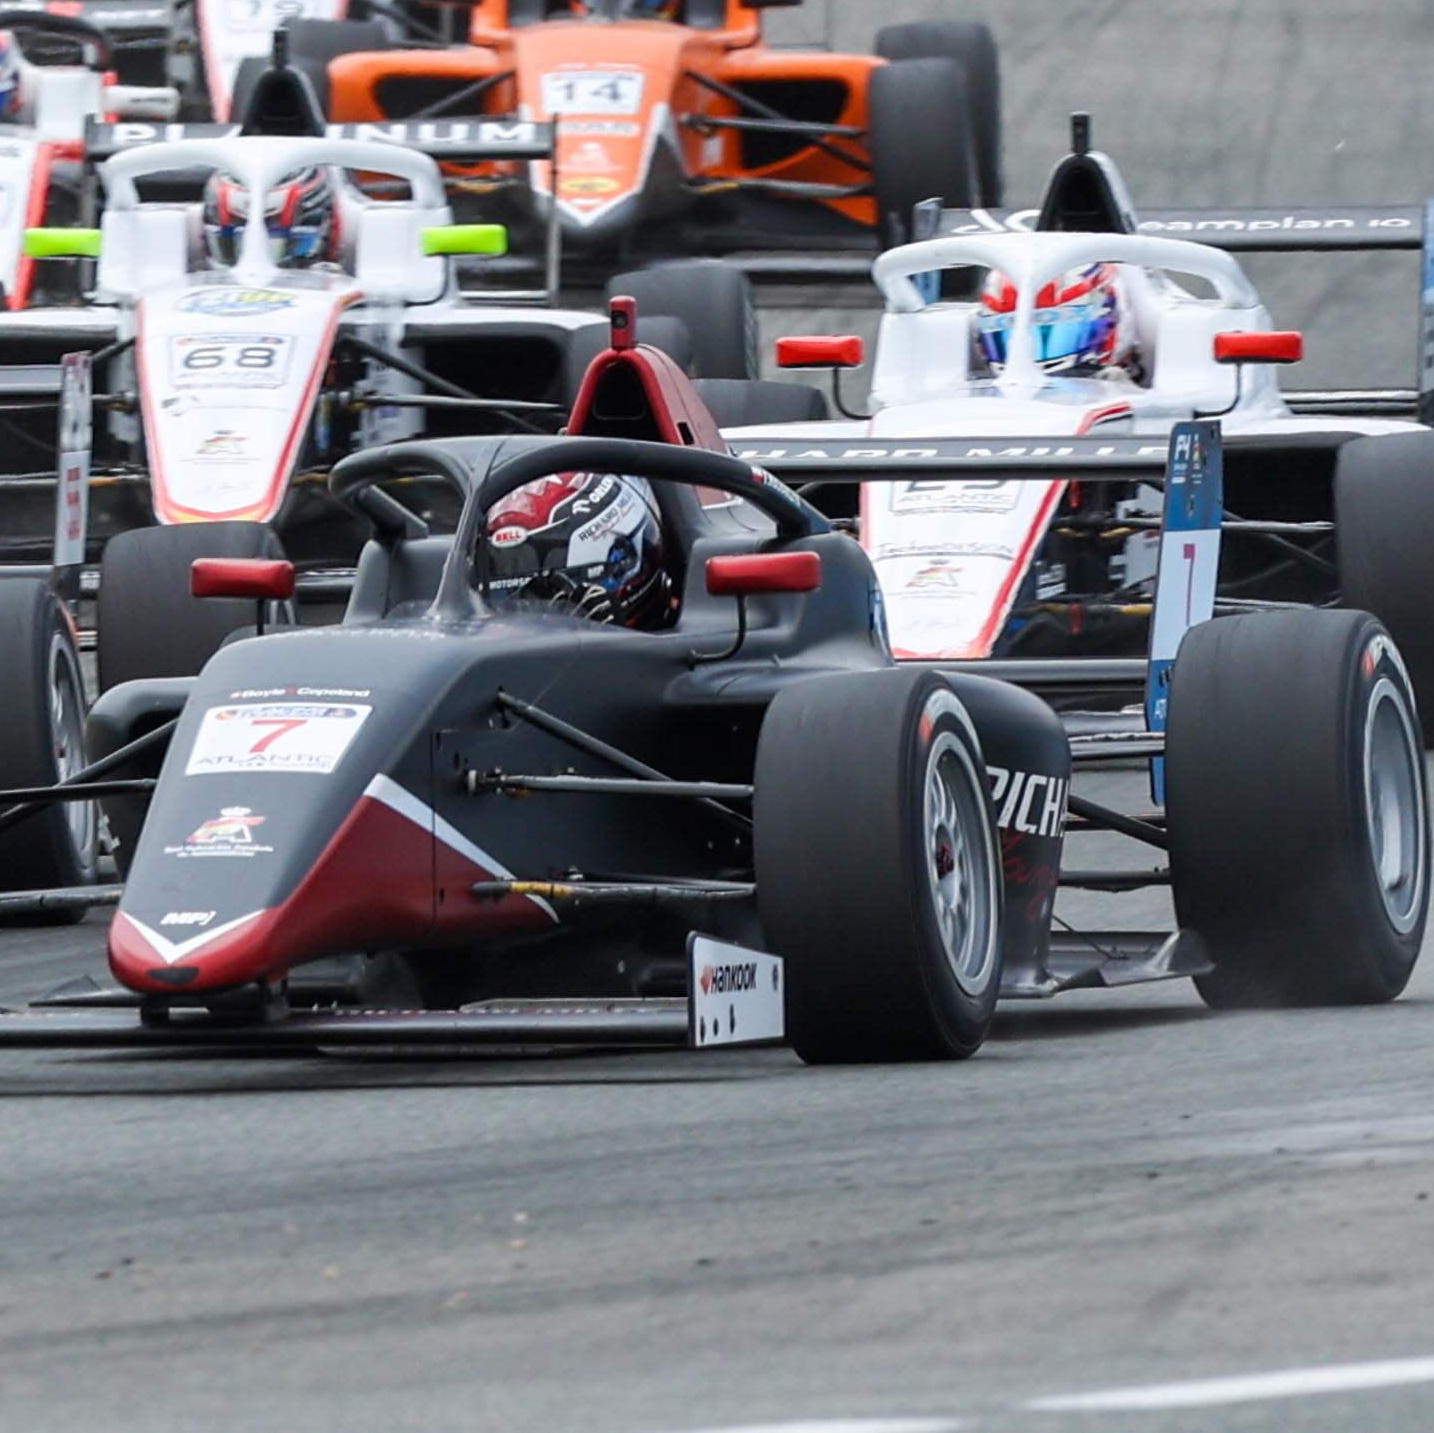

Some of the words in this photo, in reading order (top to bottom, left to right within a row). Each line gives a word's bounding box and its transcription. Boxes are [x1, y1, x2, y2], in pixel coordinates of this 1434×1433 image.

[552, 80, 623, 102] 14
[112, 122, 538, 142] PLINUM
[184, 346, 276, 370] 68
[495, 531, 522, 543] BELL
[242, 687, 287, 699] Boyle
[296, 687, 371, 698] Copeland
[248, 718, 310, 754] 7
